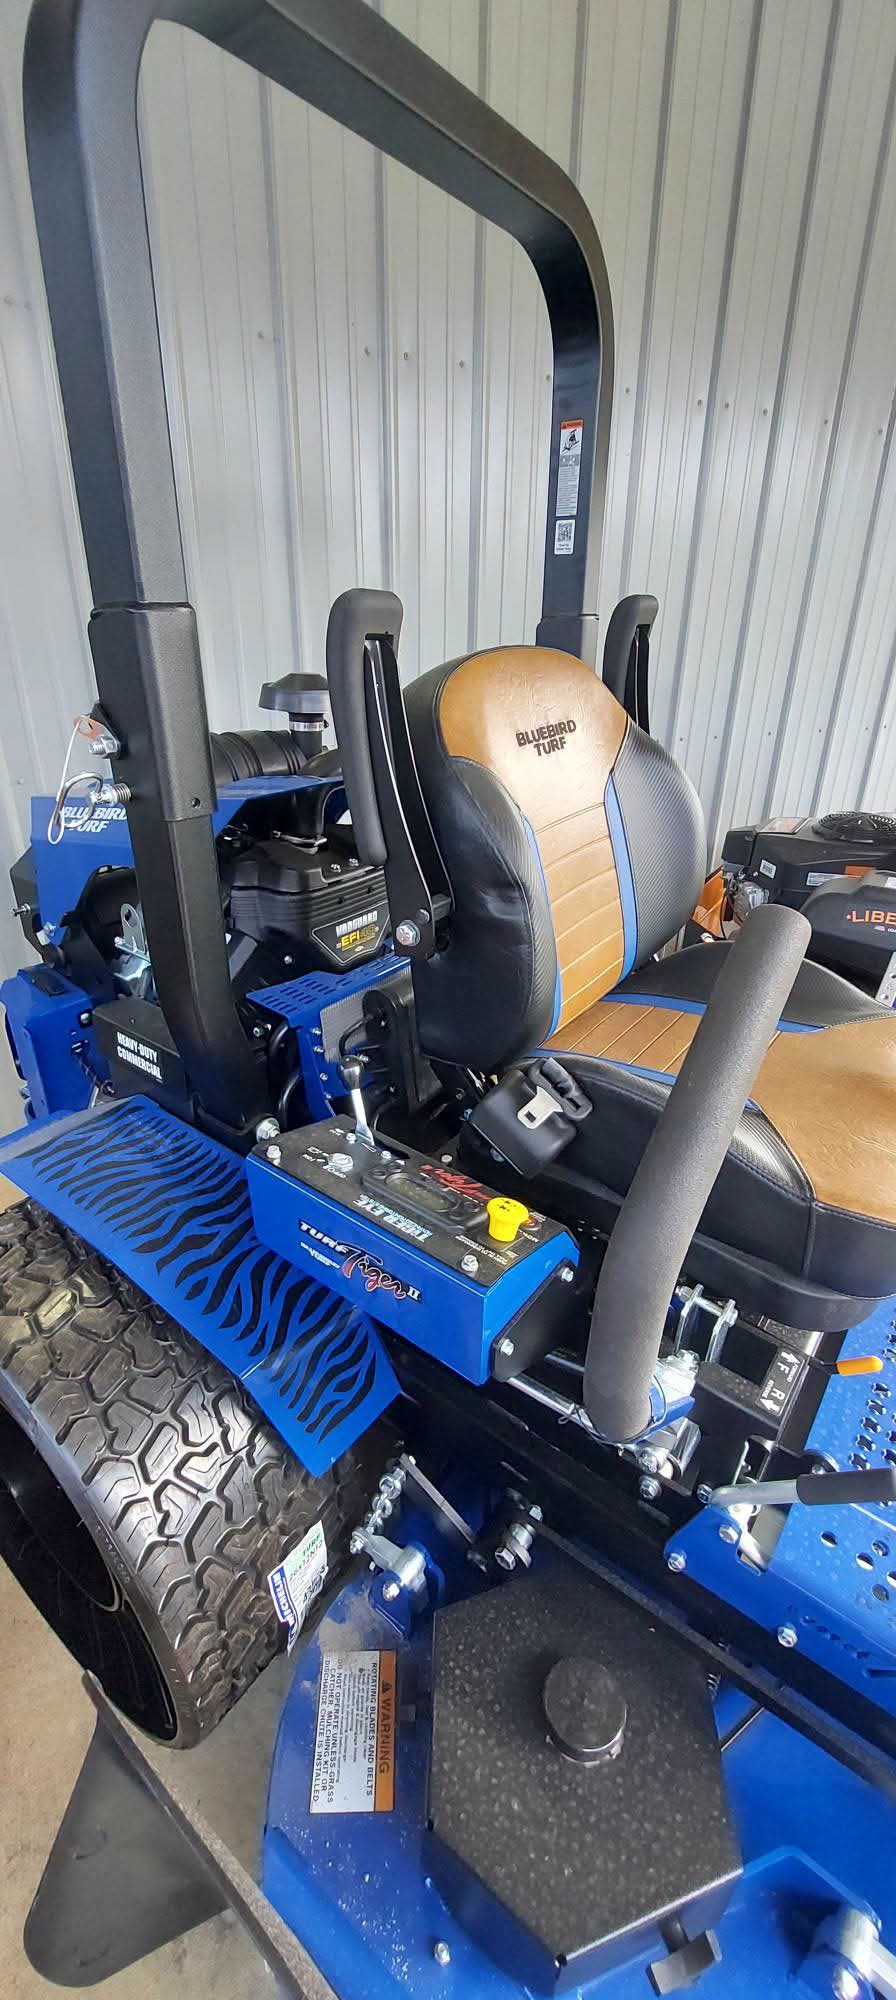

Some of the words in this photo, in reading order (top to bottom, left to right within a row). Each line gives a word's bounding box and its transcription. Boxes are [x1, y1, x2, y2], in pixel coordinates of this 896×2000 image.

[515, 719, 577, 747] BLUEBIRD
[533, 736, 566, 757] TURF
[68, 819, 109, 833] URF
[116, 1031, 158, 1063] HEAVY-DUTY
[116, 1045, 163, 1080] COMMERCIAL
[352, 1198, 386, 1217] EYE
[300, 1221, 351, 1253] TURF
[337, 1240, 407, 1299] Tiger
[777, 1361, 790, 1374] F
[771, 1387, 786, 1400] R
[322, 1661, 330, 1705] DISCHARGE
[333, 1692, 341, 1730] OPERATE
[368, 1706, 376, 1741] BLADES
[324, 1711, 333, 1757] MULCHING
[330, 1733, 338, 1768] UNLESS
[379, 1698, 392, 1774] WARNING
[313, 1752, 323, 1802] INSTALLED
[322, 1778, 327, 1791] OR
